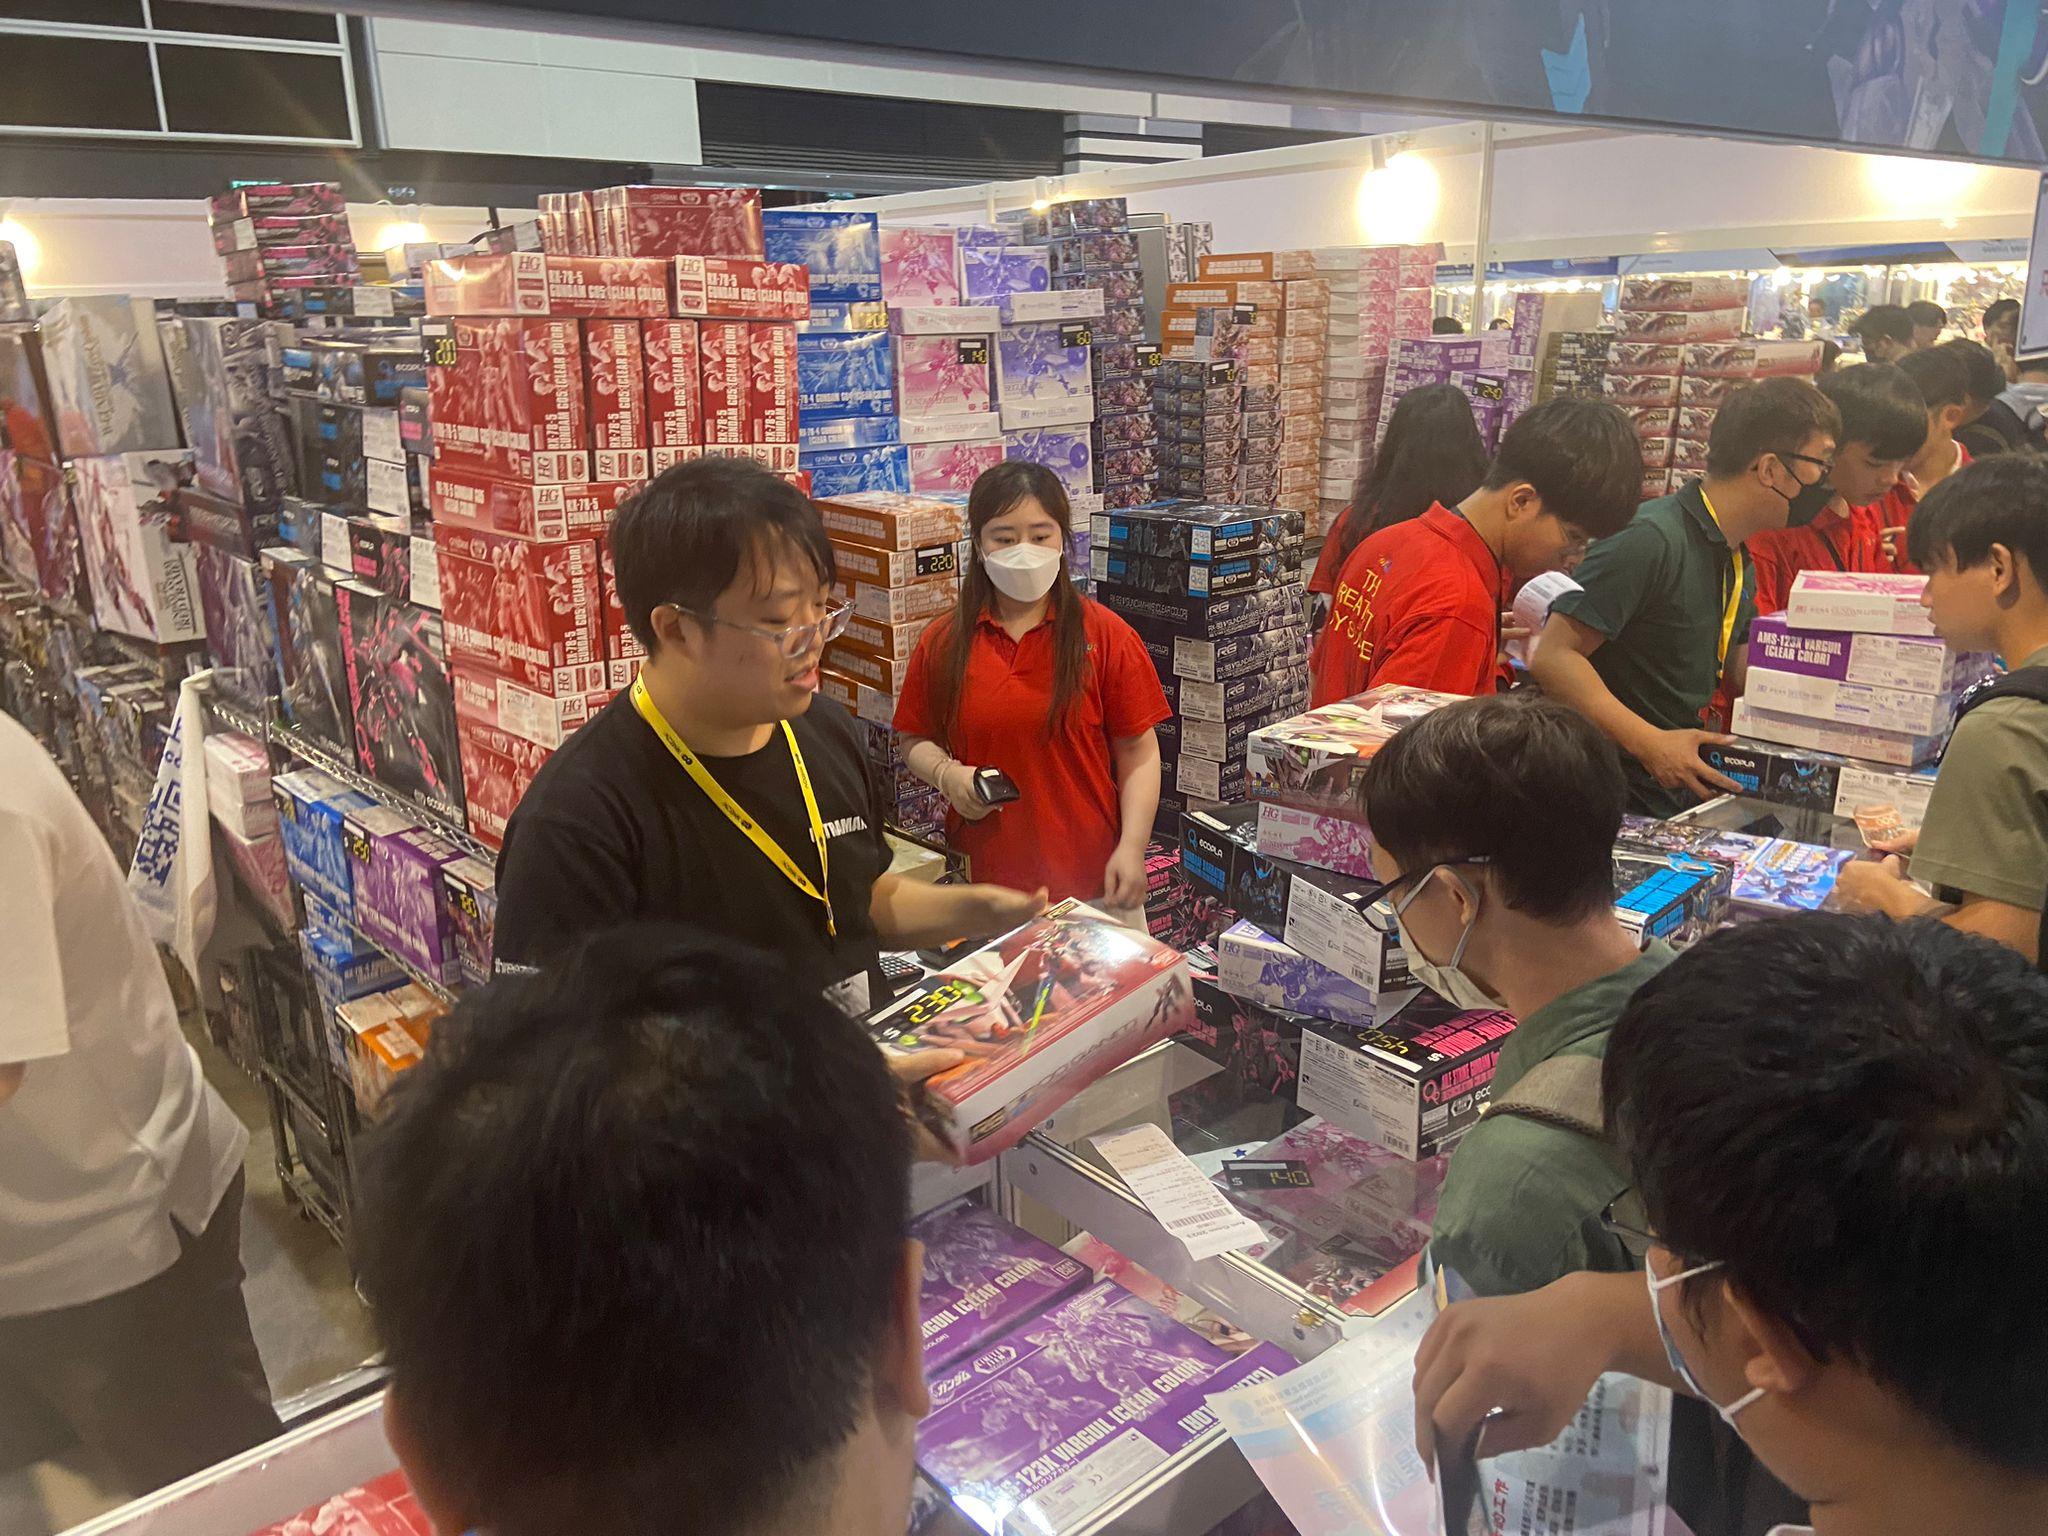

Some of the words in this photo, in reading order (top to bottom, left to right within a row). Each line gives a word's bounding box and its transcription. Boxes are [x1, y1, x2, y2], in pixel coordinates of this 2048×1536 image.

[518, 256, 541, 271] HG
[681, 257, 702, 272] HG
[545, 413, 559, 449] RX-78-5
[607, 413, 621, 448] RX-78-5
[664, 411, 677, 445] RX-78-5
[716, 409, 728, 443] RX-78-5
[765, 409, 776, 442] RX-78-5
[538, 456, 550, 478] HG
[601, 454, 613, 476] HG
[539, 489, 560, 503] HG
[930, 554, 954, 572] 220
[1208, 601, 1230, 616] RG
[564, 631, 578, 665] RX-78-5
[576, 627, 591, 664] GUNDAM
[1217, 642, 1238, 658] RG
[1757, 631, 1802, 649] AMS-123X
[1804, 638, 1842, 656] VARGUIL
[557, 672, 571, 692] HG
[613, 664, 626, 684] HG
[1226, 682, 1246, 698] RG
[562, 699, 582, 714] HG
[1228, 722, 1246, 738] RG
[1221, 761, 1241, 778] RG
[1263, 806, 1279, 819] HG
[1223, 941, 1240, 955] HG
[903, 985, 964, 1024] 230
[1357, 1028, 1409, 1055] 450
[1271, 1170, 1311, 1186] 140
[1050, 1417, 1117, 1462] VARGUIL
